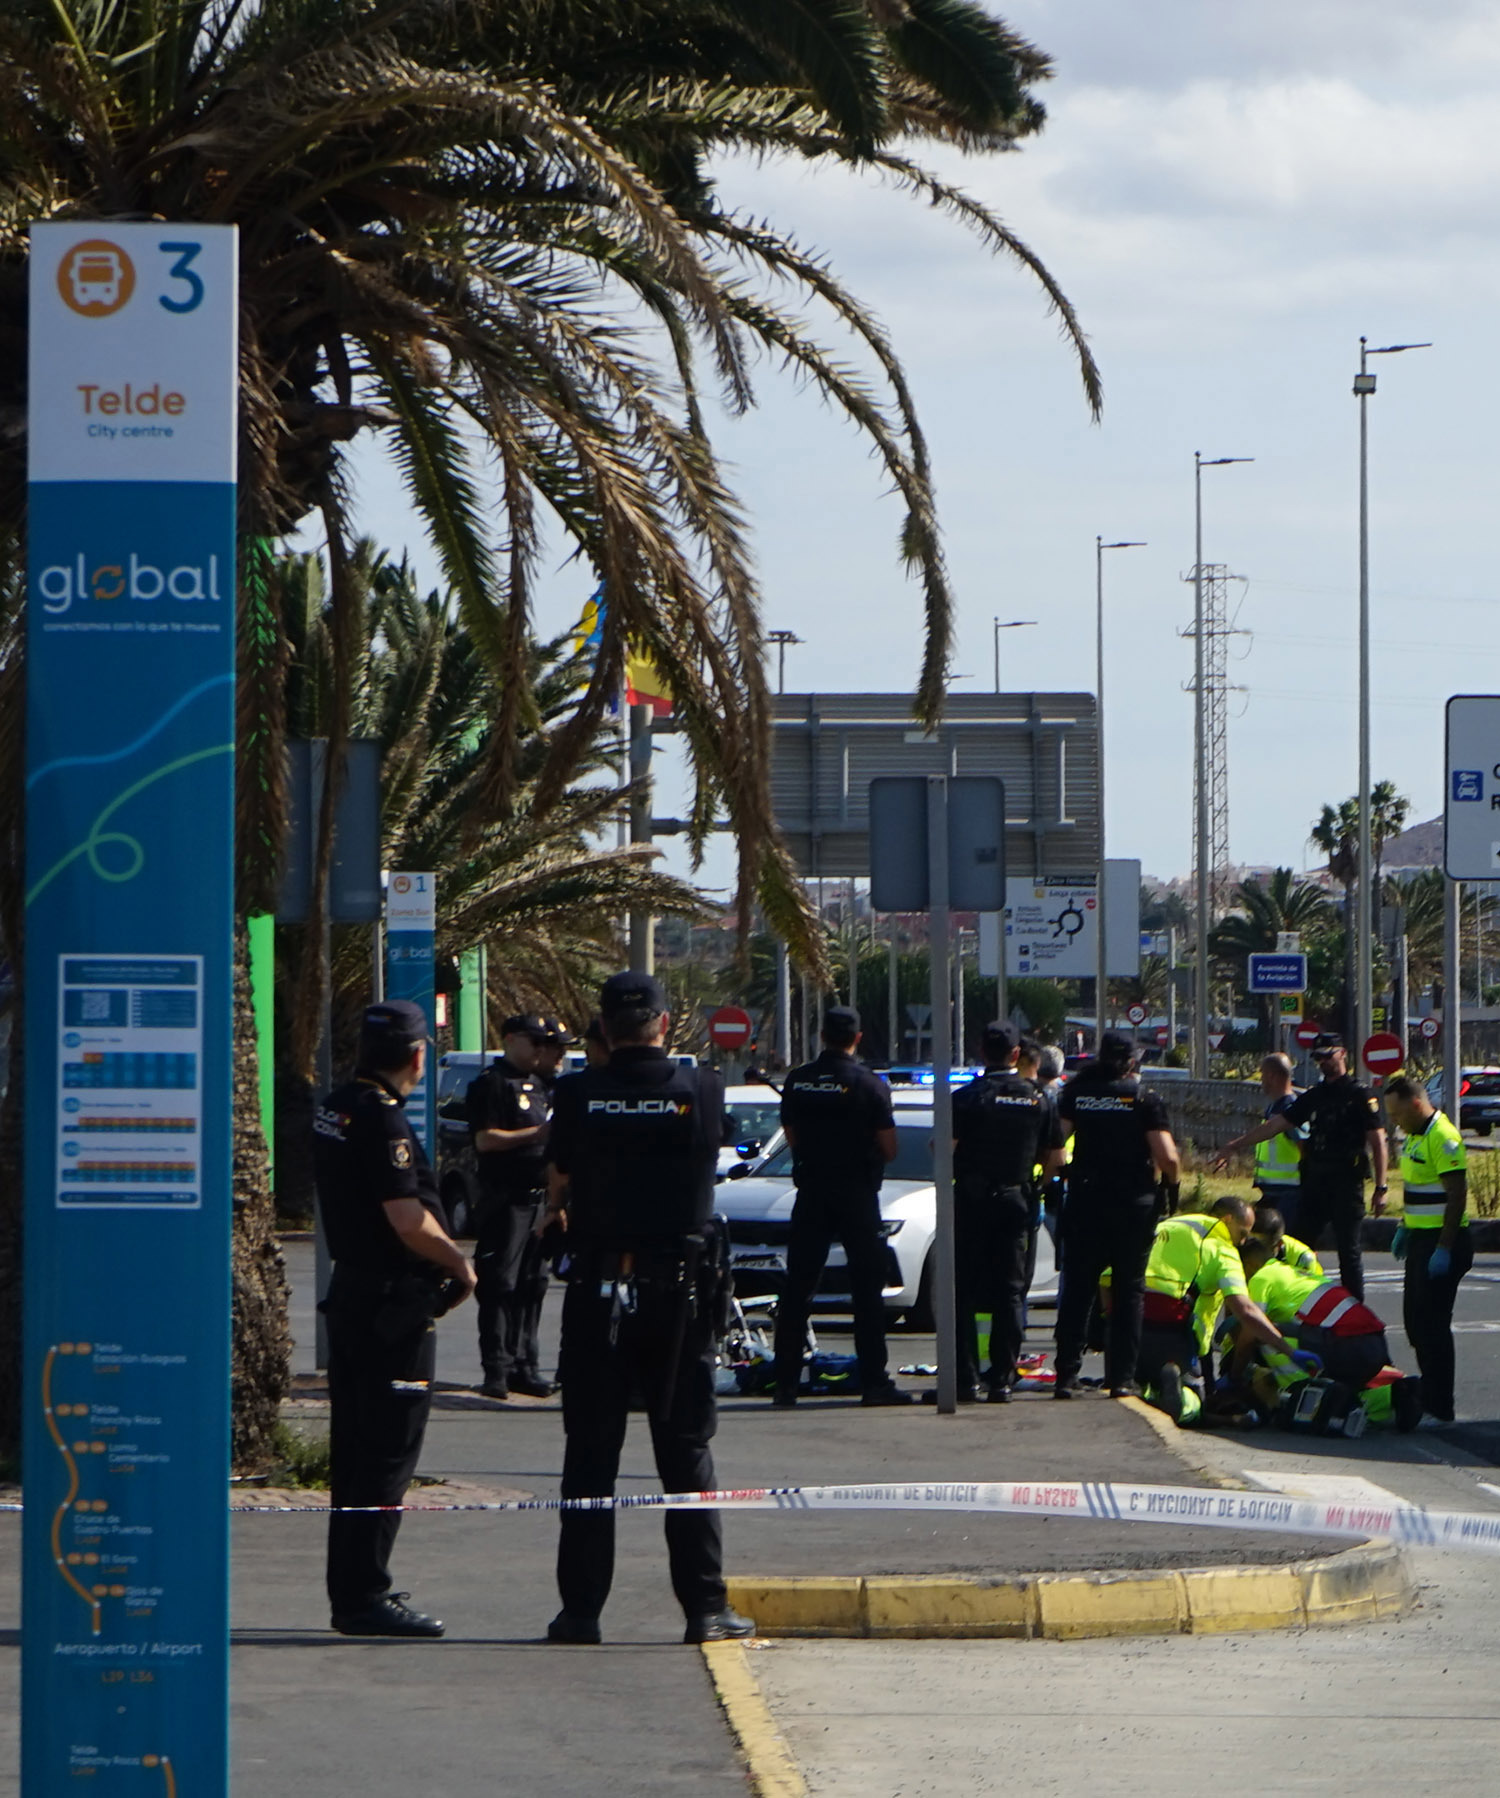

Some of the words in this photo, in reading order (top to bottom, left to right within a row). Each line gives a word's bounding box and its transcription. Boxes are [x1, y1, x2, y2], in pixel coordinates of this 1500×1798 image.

[157, 240, 205, 315] 3
[77, 384, 187, 416] Telde
[87, 423, 118, 440] City
[122, 424, 174, 438] centre
[38, 553, 222, 613] global
[415, 875, 428, 893] 1
[587, 1099, 679, 1115] POLICIA
[54, 1643, 138, 1658] Aeropuerto
[150, 1643, 203, 1657] Airport
